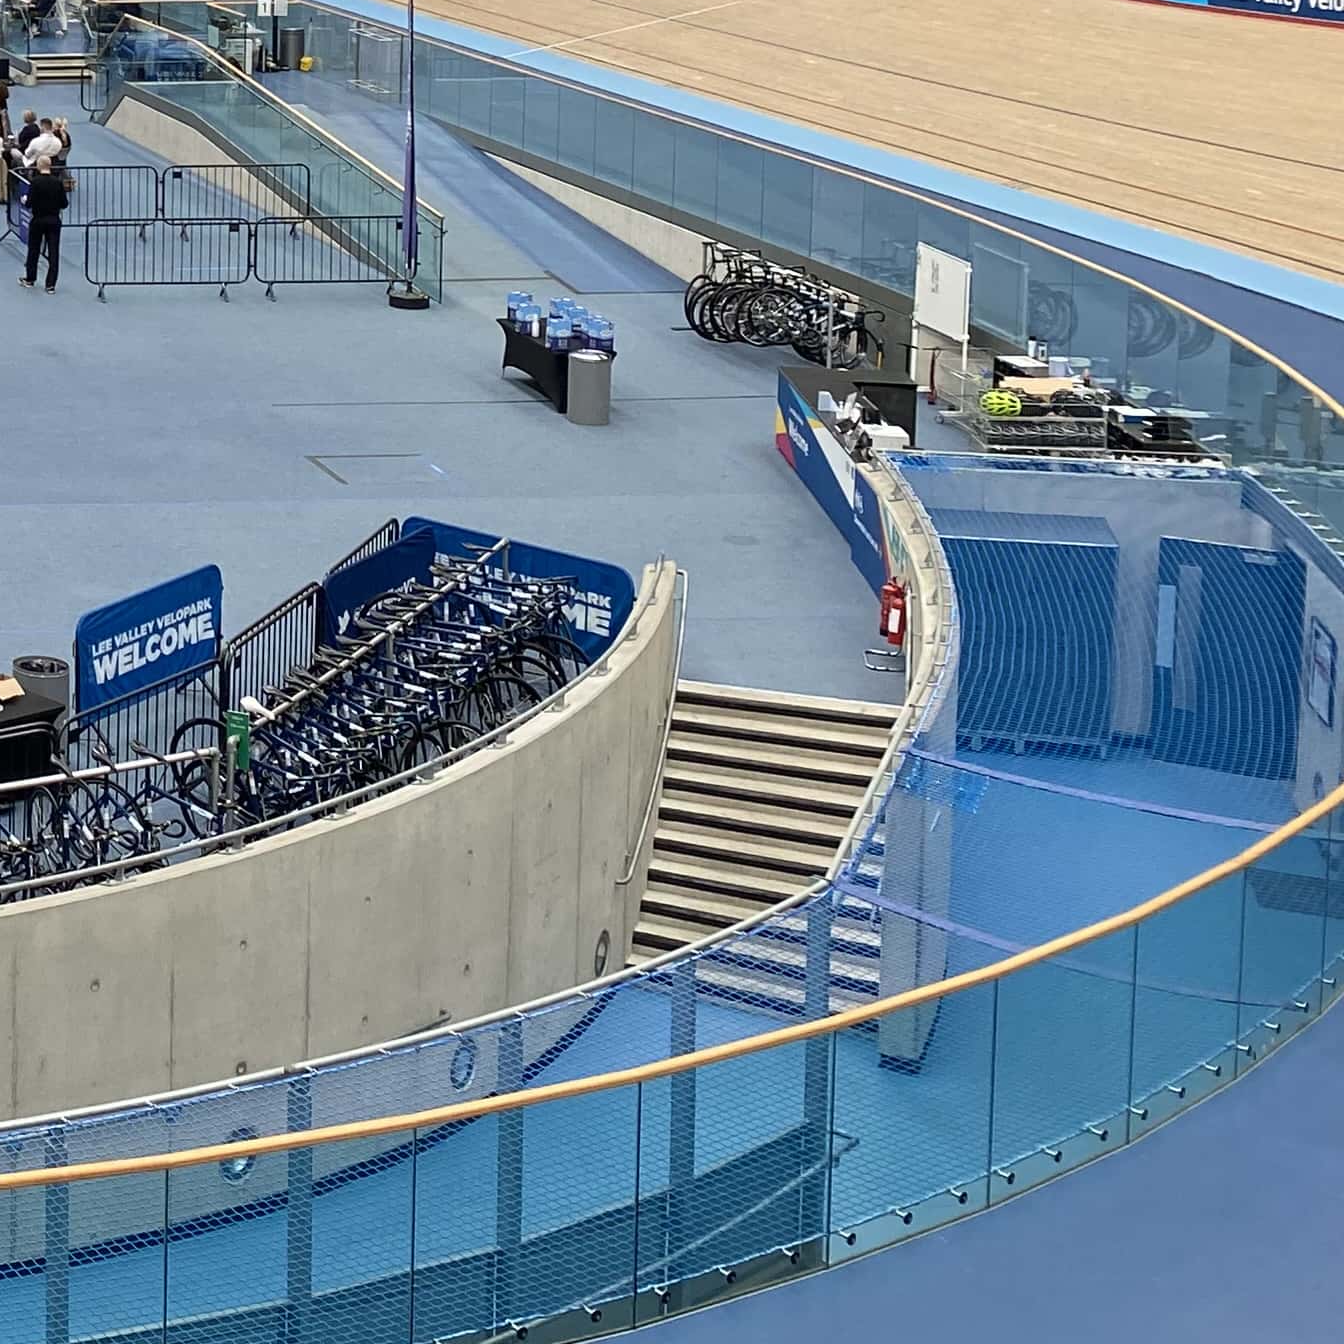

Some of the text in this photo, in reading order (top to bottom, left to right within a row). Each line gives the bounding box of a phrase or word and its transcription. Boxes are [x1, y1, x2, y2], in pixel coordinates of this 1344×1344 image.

[92, 597, 213, 657] LEE VALLEY VELOPARK
[93, 612, 215, 685] WELCOME
